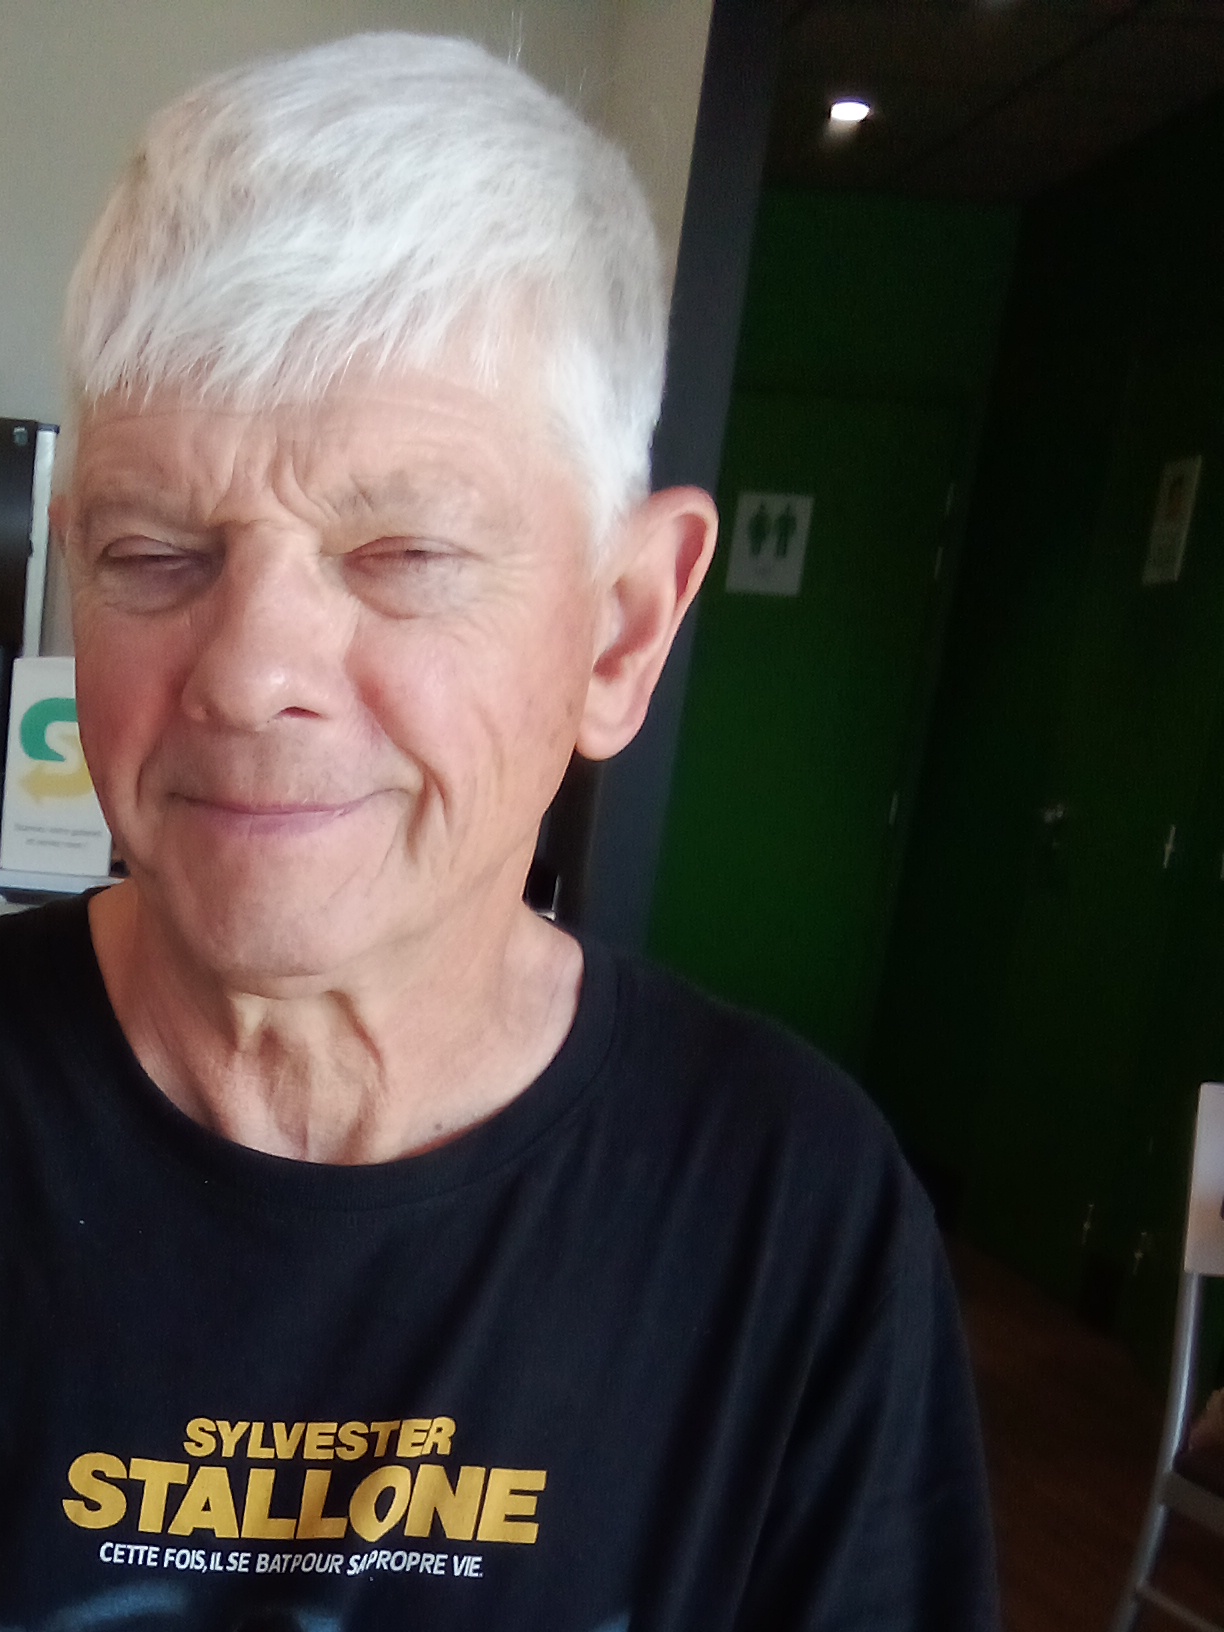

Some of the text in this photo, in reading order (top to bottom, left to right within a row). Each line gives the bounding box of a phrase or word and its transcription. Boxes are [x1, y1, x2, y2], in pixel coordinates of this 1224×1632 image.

[183, 1416, 457, 1461] SYLVESTER
[61, 1451, 548, 1545] STALLONE
[99, 1541, 160, 1567] CETTE
[163, 1547, 208, 1574] FOIS,
[209, 1551, 225, 1572] IL
[226, 1551, 252, 1573] SE
[255, 1552, 293, 1574] BAT
[289, 1551, 344, 1574] POUR
[364, 1549, 449, 1576] PROPRE
[453, 1554, 484, 1578] VIE.
